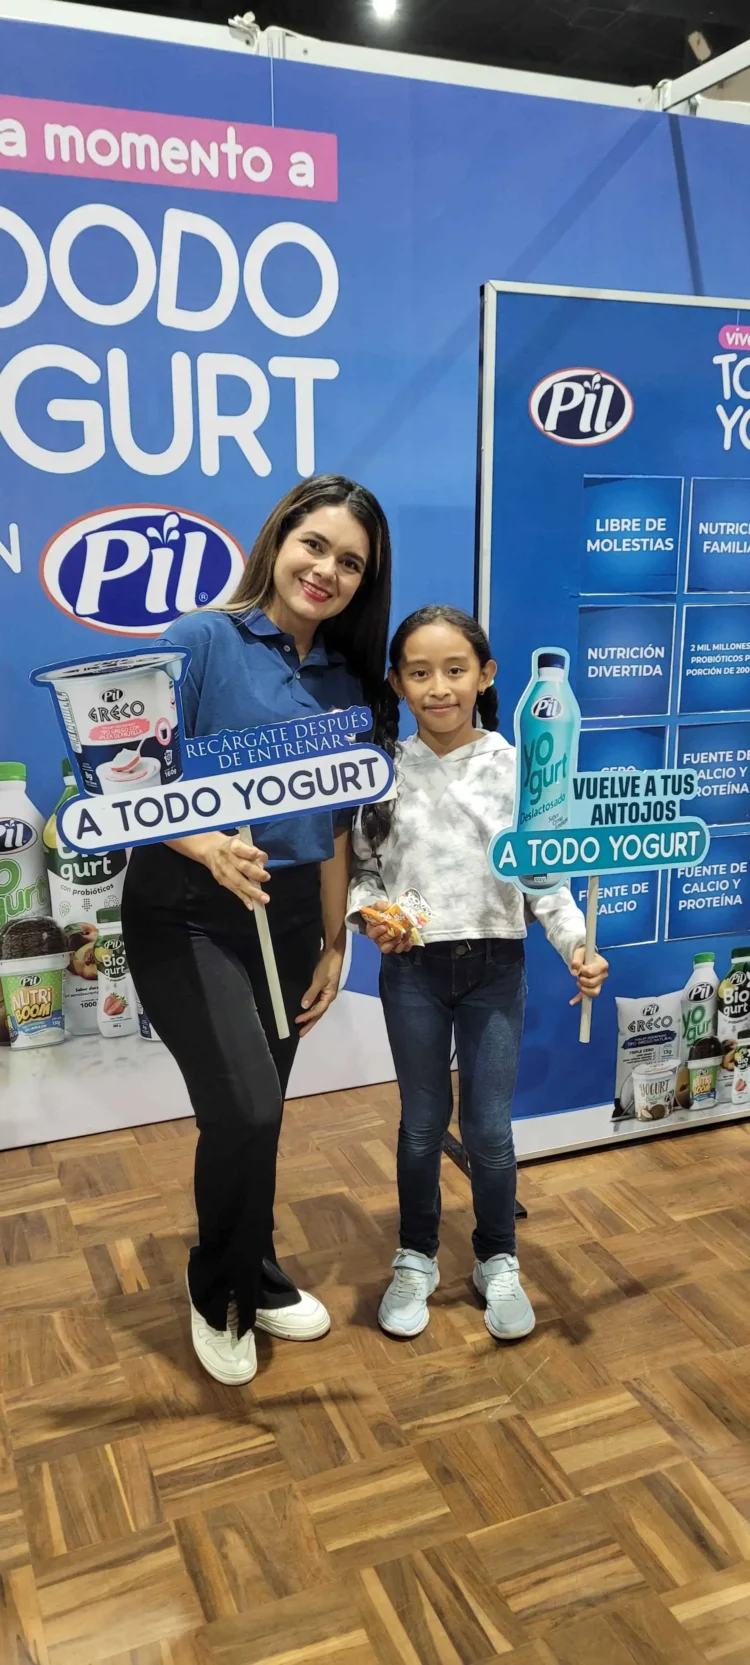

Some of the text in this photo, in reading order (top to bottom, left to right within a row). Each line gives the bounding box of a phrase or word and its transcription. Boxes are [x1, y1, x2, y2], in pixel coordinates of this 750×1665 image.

[288, 151, 315, 188] a
[544, 373, 615, 433] Pil
[596, 518, 666, 532] LIBRE DE
[586, 538, 674, 552] MOLESTIAS
[75, 511, 207, 615] Pil
[587, 644, 665, 659] NUTRICIÓN
[691, 654, 743, 663] PROBIÓTICOS
[587, 664, 663, 678] DIVERTIDA
[686, 666, 722, 676] PORCIÓN
[104, 688, 120, 702] Pil
[88, 700, 145, 722] GRECO
[535, 697, 559, 717] Pil
[186, 711, 369, 759] RECÁRGATE DESPUÉS
[218, 734, 344, 769] DE ENTRENAR
[524, 732, 554, 788] yo
[683, 751, 733, 764] FUENTE
[530, 752, 568, 806] gurt
[697, 766, 748, 780] ALCIO Y
[573, 774, 694, 800] VUELVE A TUS
[697, 781, 749, 797] ROTEÍNA
[77, 757, 379, 840] A TODO YOGURT
[520, 793, 566, 826] Deslactosado
[590, 800, 676, 826] ANTOJOS
[499, 831, 700, 869] A TODO YOGURT
[60, 857, 112, 883] gurt
[677, 862, 748, 879] FUENTE DE
[61, 884, 114, 895] con probióticos
[578, 882, 649, 901] FENTE DE
[682, 878, 741, 894] CALCIO Y
[597, 900, 637, 915] ALCIO
[679, 893, 743, 911] PROTEÍNA
[102, 954, 125, 967] Bio
[104, 966, 125, 977] gurt
[22, 976, 37, 986] Pil
[690, 984, 710, 1000] Pil
[724, 986, 750, 1004] Bio
[15, 1002, 52, 1023] BOOM
[80, 1001, 97, 1009] 1000
[643, 1003, 658, 1016] Pil
[723, 1002, 748, 1017] gurt
[627, 1015, 673, 1033] GRECO
[682, 1005, 705, 1039] yo
[639, 1079, 671, 1098] YOGURT
